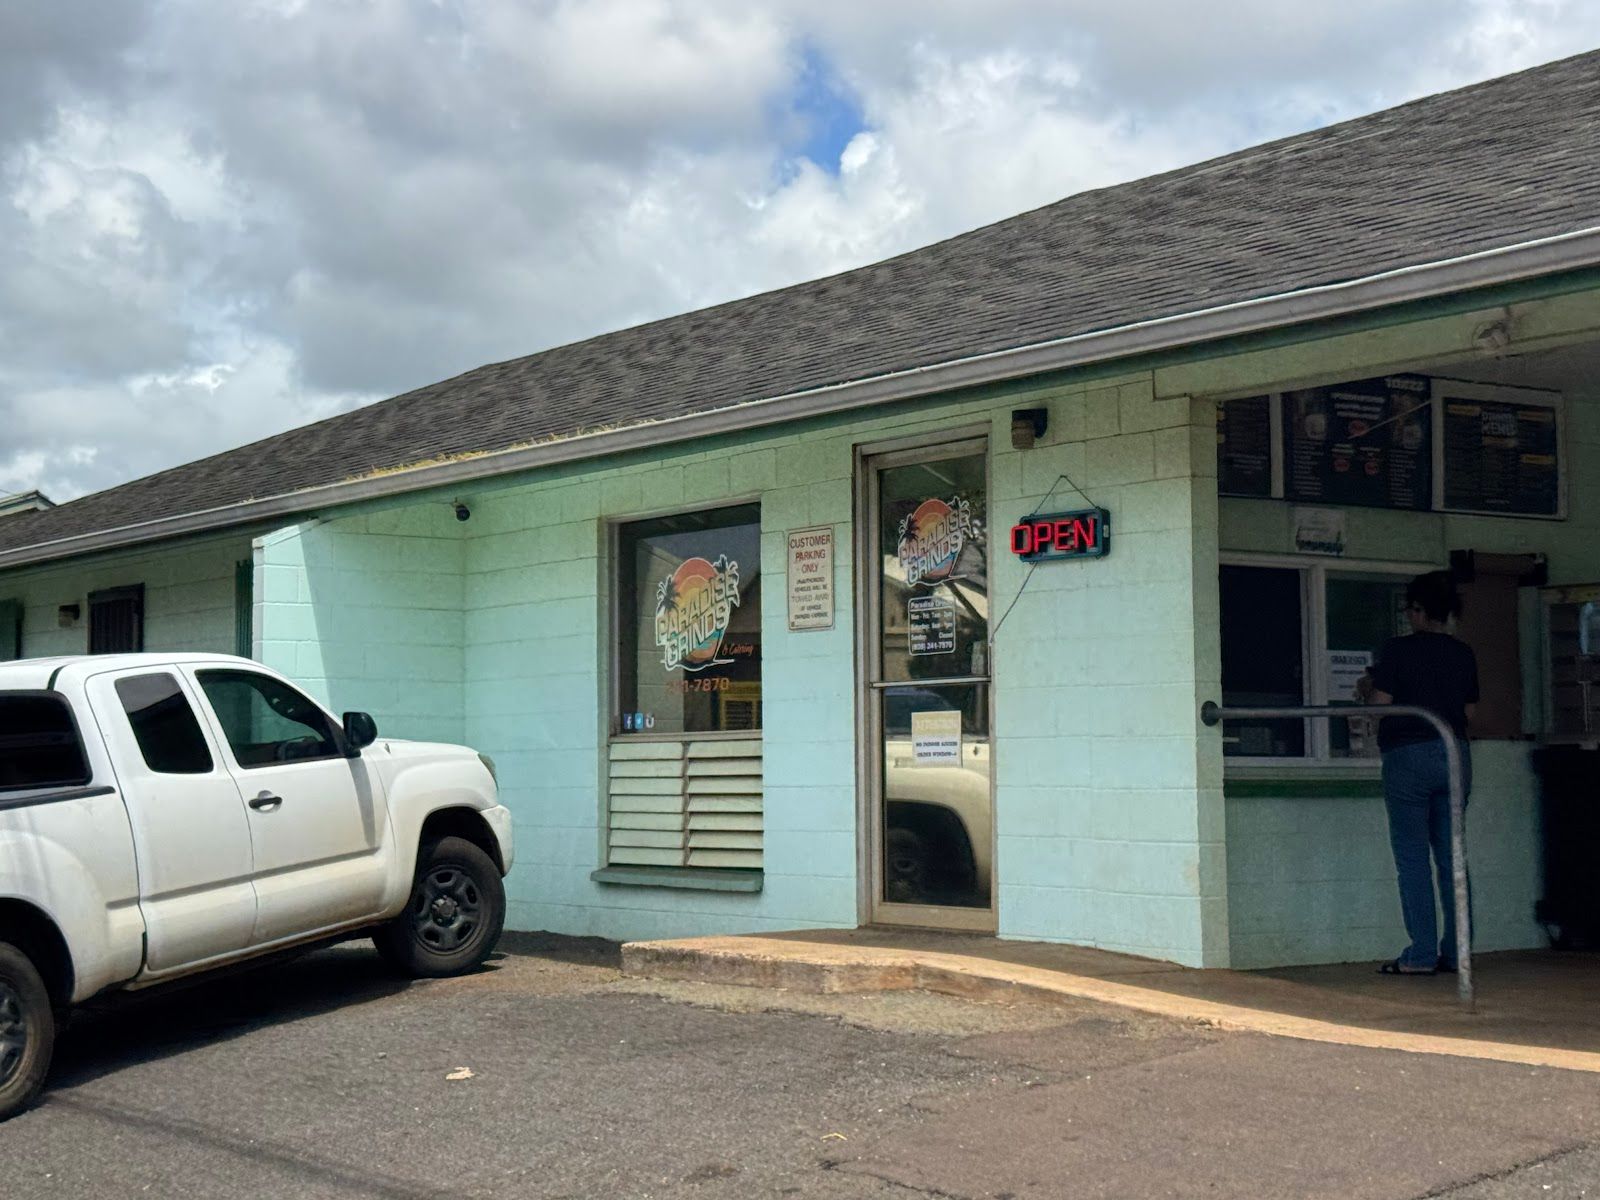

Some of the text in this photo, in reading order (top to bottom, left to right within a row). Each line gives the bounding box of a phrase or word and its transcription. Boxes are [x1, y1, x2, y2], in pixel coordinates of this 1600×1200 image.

[790, 534, 831, 549] CUSTOMER
[795, 549, 826, 561] PARKING
[900, 508, 970, 567] PARADISE
[1010, 517, 1095, 555] OPEN
[801, 563, 819, 574] ONLY
[908, 530, 963, 583] GRINDS
[657, 569, 739, 643] PARADISE
[666, 601, 730, 666] GRINDS
[666, 677, 730, 695] 1-7870
